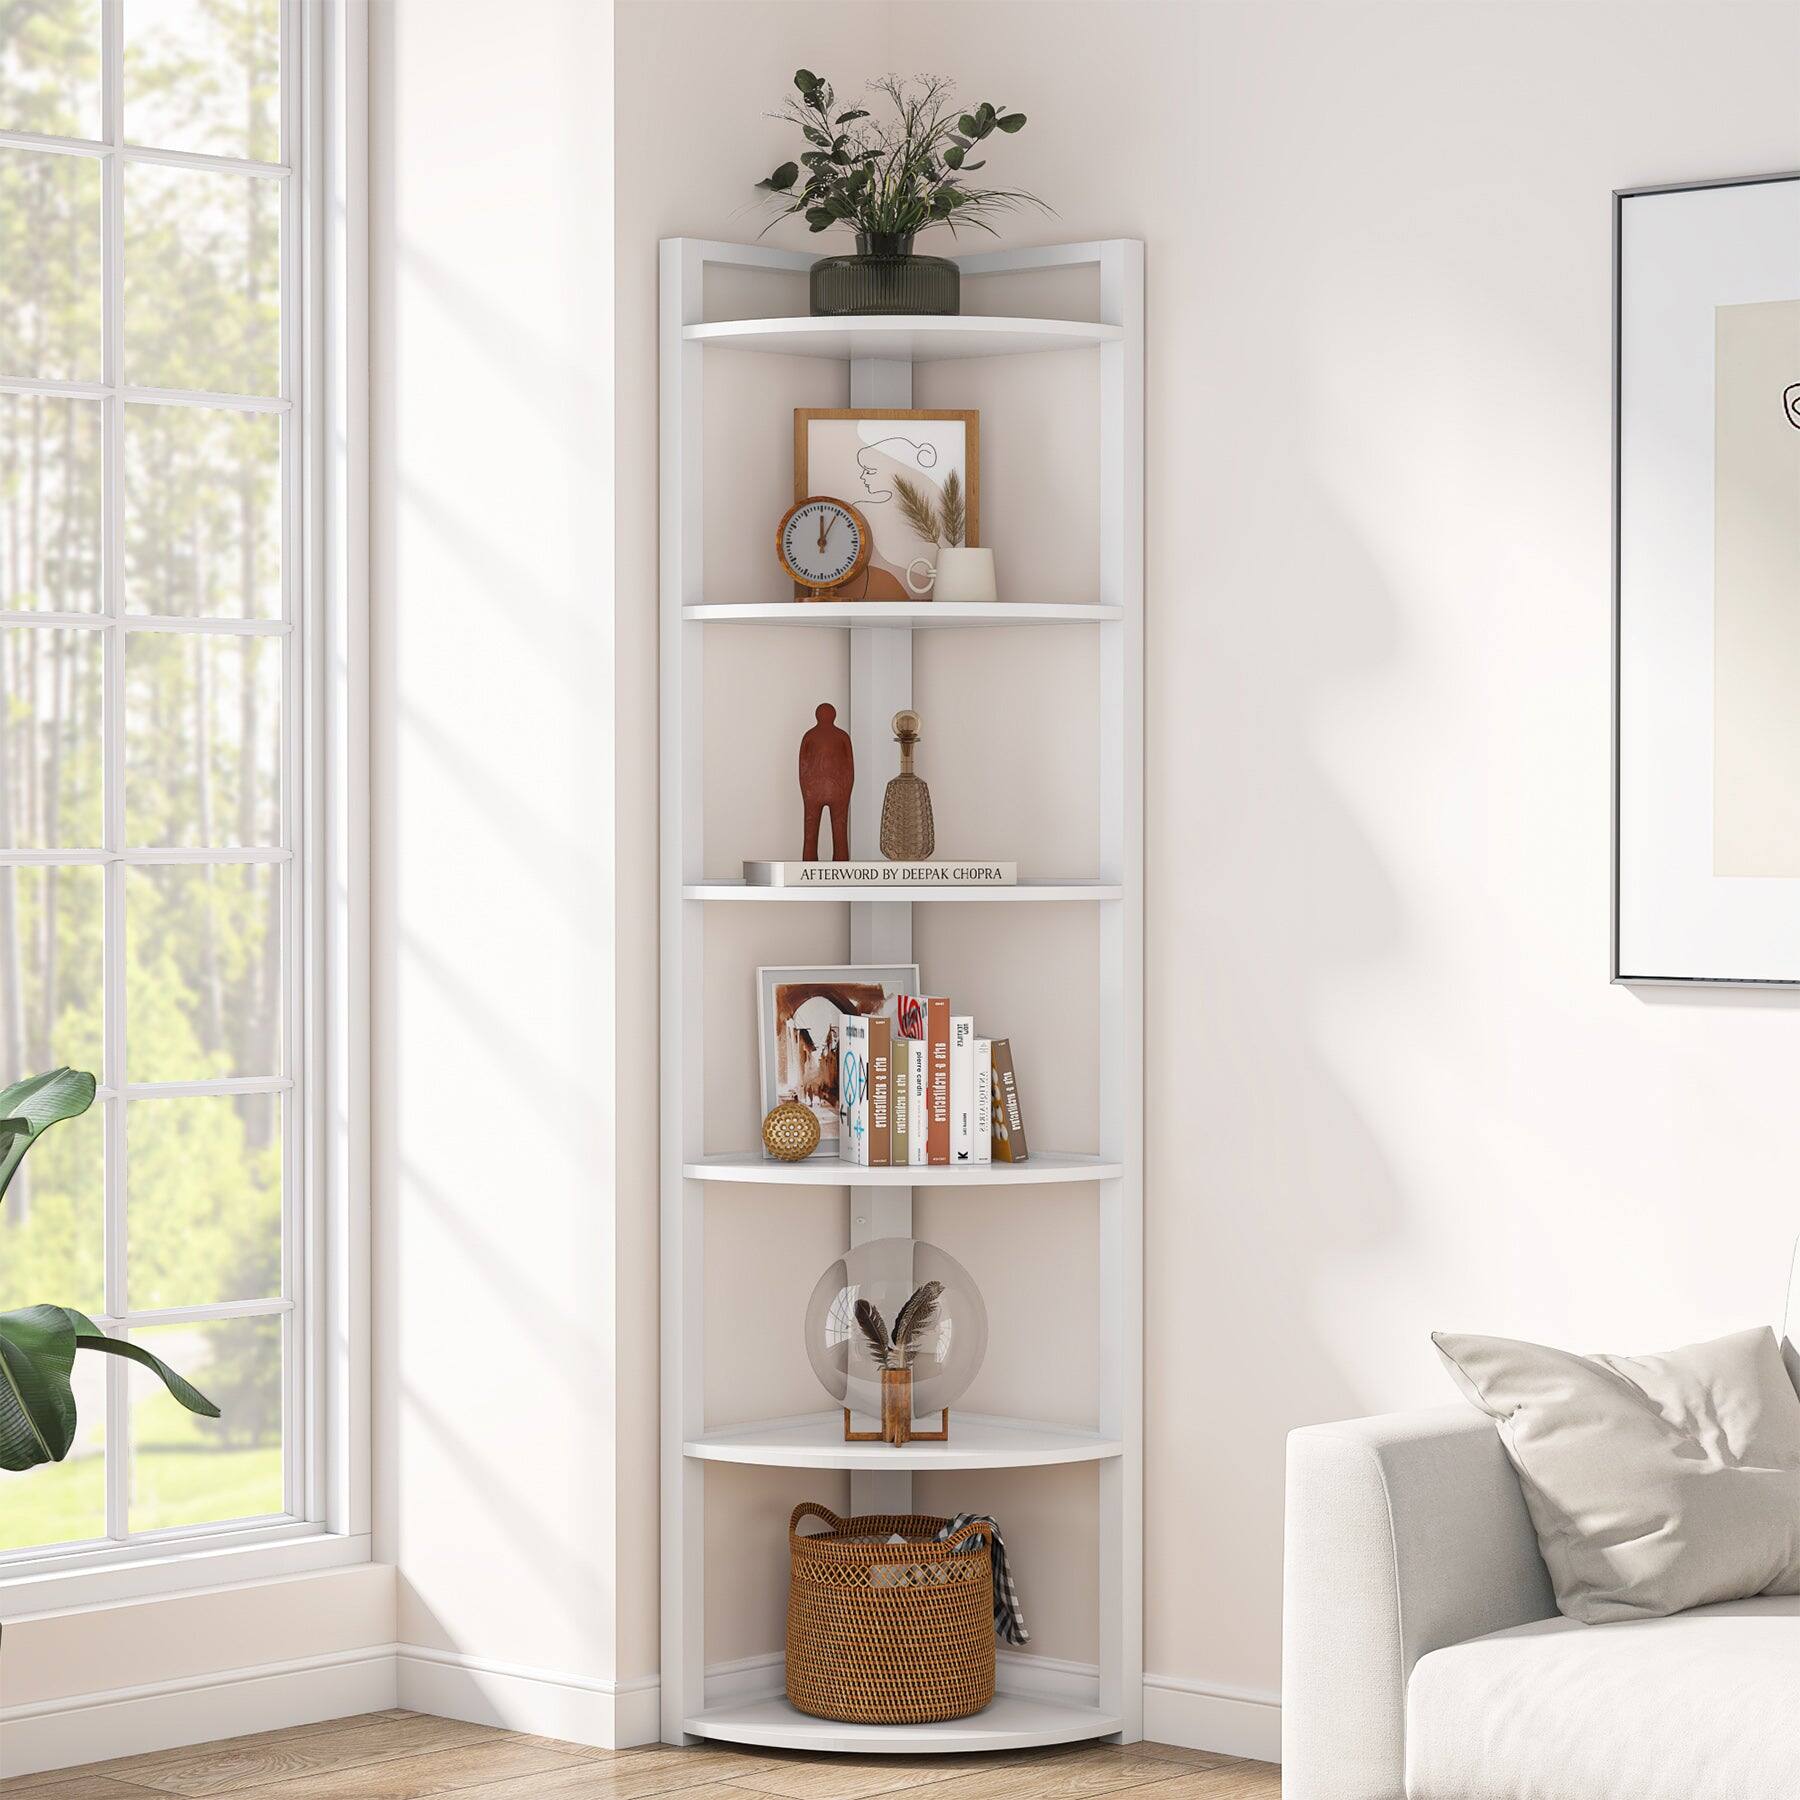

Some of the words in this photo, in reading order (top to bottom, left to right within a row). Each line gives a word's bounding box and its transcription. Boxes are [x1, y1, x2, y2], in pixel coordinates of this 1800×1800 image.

[800, 868, 879, 881] AFTERWORD
[883, 868, 899, 880] BY
[902, 868, 949, 880] DEEPAK
[953, 867, 1002, 880] CHOPRA
